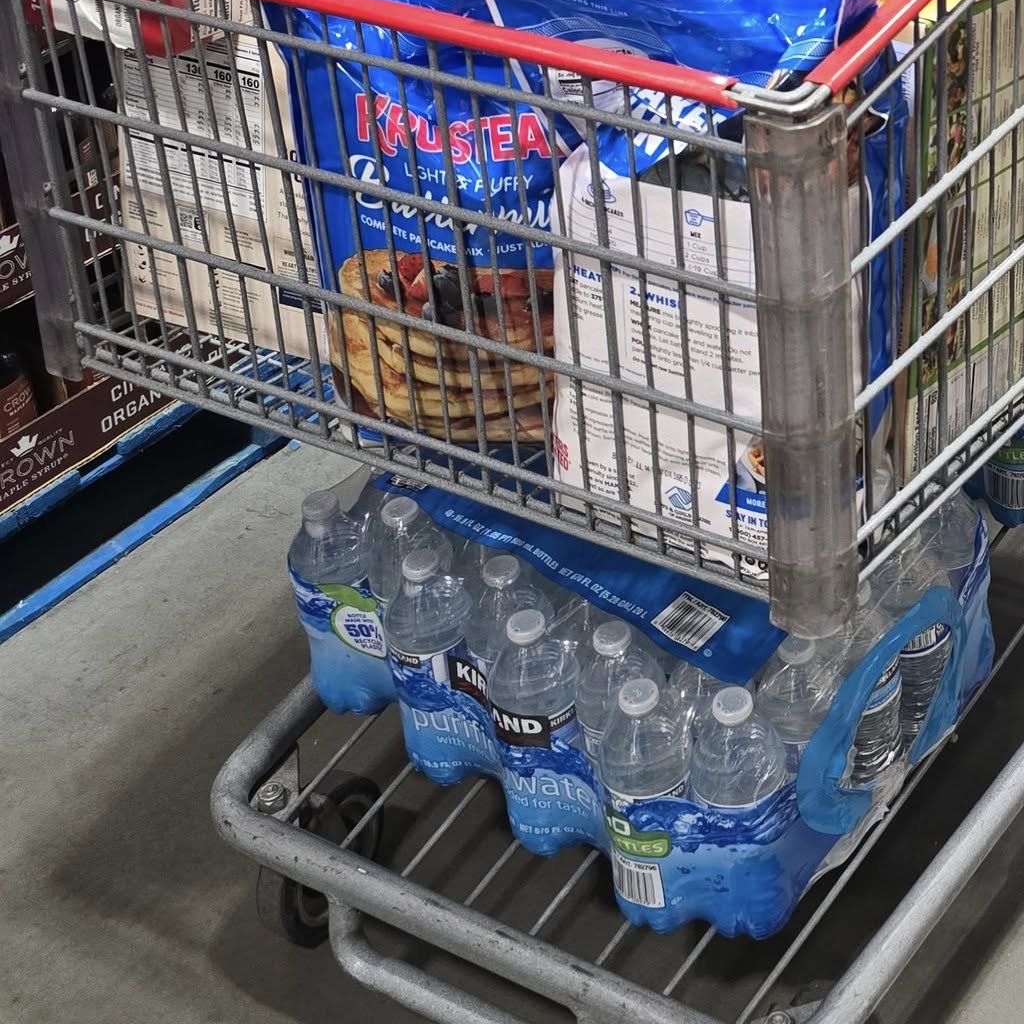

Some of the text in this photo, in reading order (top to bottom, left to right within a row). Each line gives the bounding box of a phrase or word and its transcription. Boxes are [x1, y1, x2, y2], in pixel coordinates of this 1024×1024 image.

[590, 2, 608, 12] THIS
[213, 70, 232, 82] 160
[241, 77, 260, 89] 160
[690, 230, 702, 239] MIX
[692, 242, 707, 252] Cup
[691, 253, 710, 264] Cups
[573, 264, 604, 283] HEAT
[630, 286, 641, 297] 2.
[691, 346, 708, 355] stand
[38, 427, 63, 446] QUALITY
[31, 457, 63, 480] SYRUP
[746, 497, 765, 508] MORE
[747, 516, 758, 525] IN
[533, 546, 602, 594] BOTTLES FL OZ
[343, 623, 384, 642] 50%
[436, 735, 466, 748] with
[511, 771, 599, 816] water
[533, 796, 588, 817] for taste
